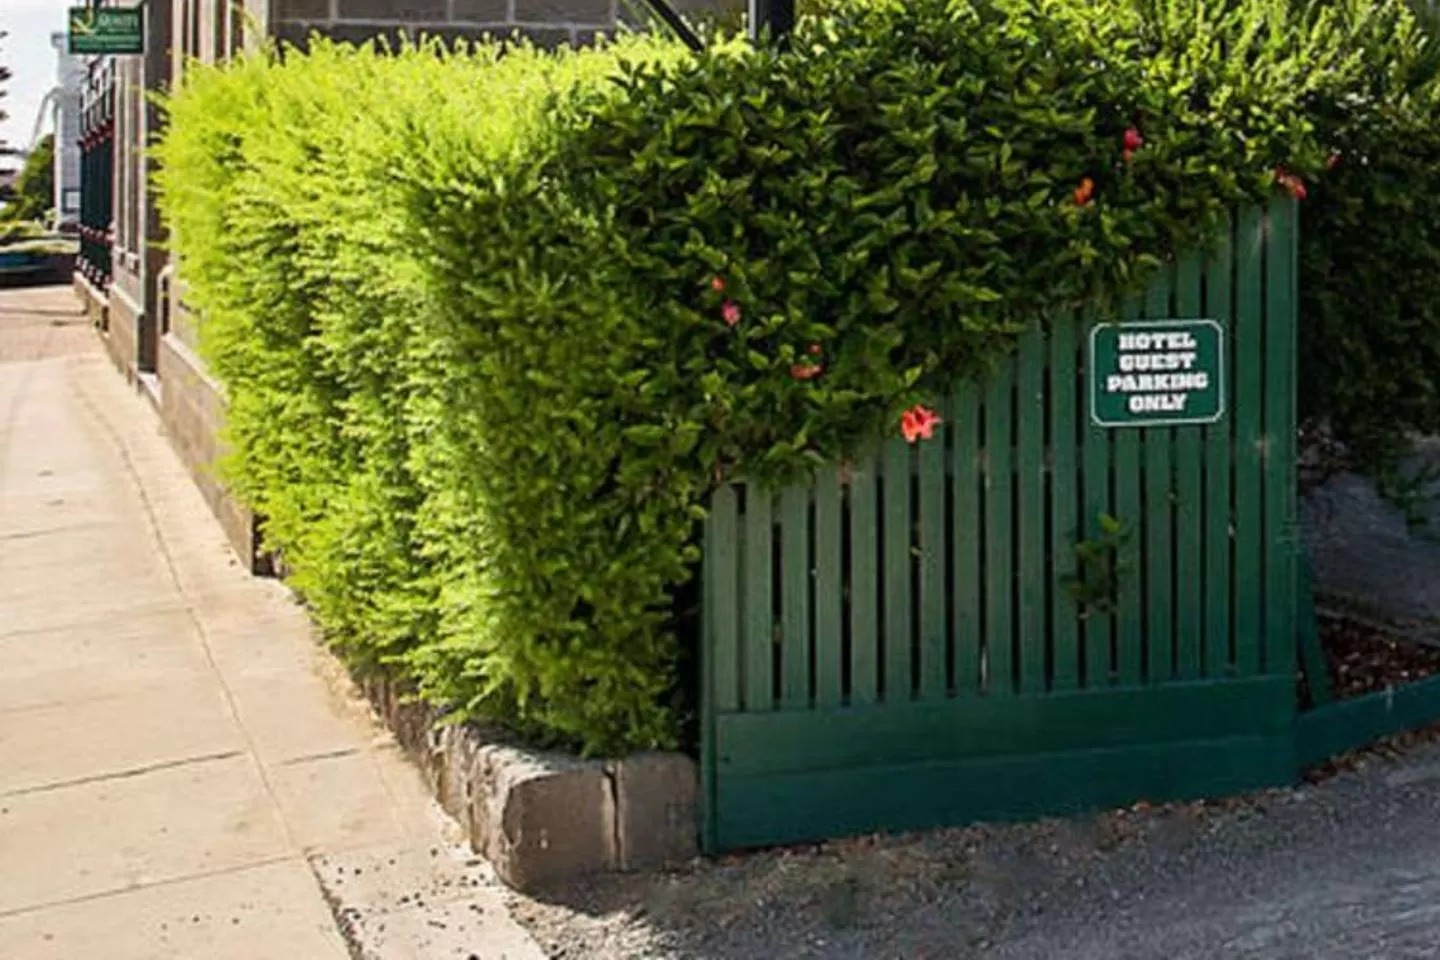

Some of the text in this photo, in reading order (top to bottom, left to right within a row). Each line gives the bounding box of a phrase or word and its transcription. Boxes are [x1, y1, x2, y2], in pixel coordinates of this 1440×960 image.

[1118, 332, 1197, 350] HOTEL
[1118, 352, 1197, 371] GUEST
[1106, 373, 1209, 392] PARKING
[1128, 393, 1188, 413] ONLY
